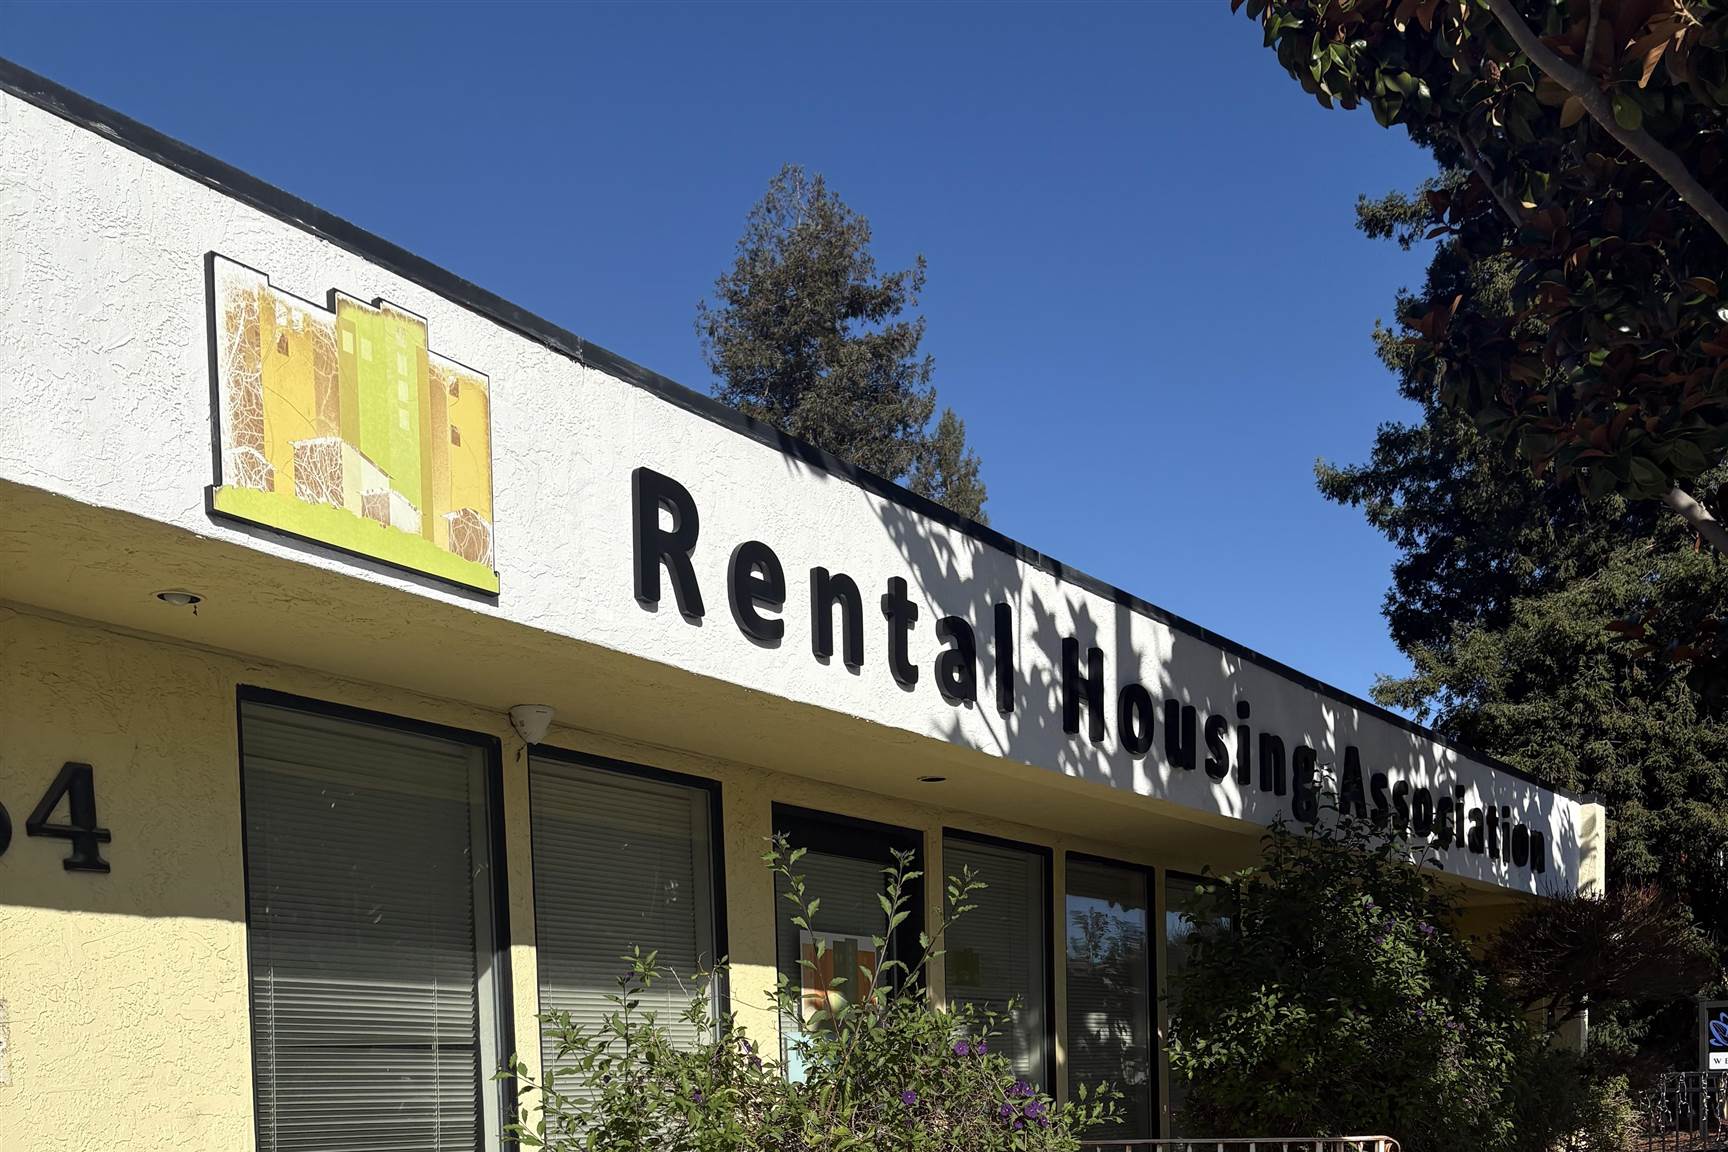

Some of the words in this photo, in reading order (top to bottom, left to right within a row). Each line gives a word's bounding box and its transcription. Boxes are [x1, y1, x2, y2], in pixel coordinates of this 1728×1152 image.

[632, 466, 1014, 715] Rental
[1062, 637, 1317, 823] Housing
[1339, 745, 1545, 874] Association
[0, 762, 111, 873] 4
